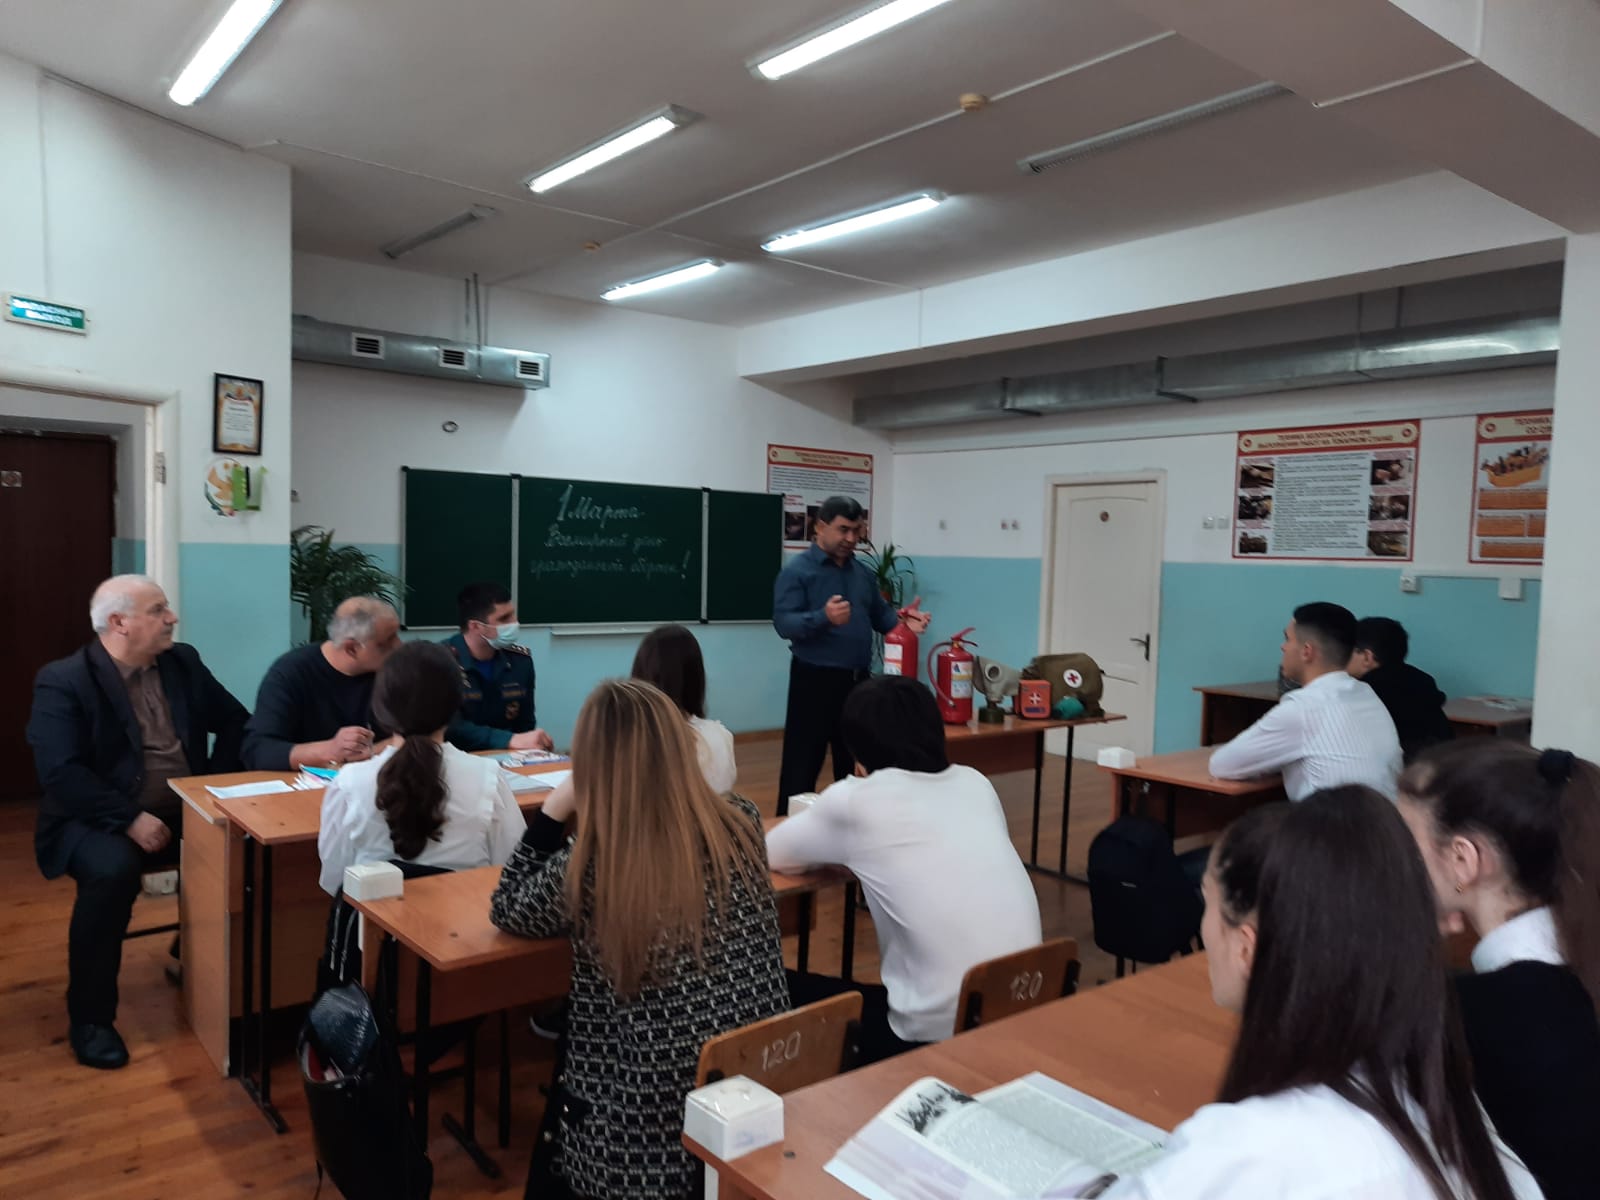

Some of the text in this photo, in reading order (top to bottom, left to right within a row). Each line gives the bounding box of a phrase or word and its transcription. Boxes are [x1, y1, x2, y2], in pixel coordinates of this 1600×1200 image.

[556, 484, 645, 528] 1 Марта
[762, 1031, 801, 1072] 120
